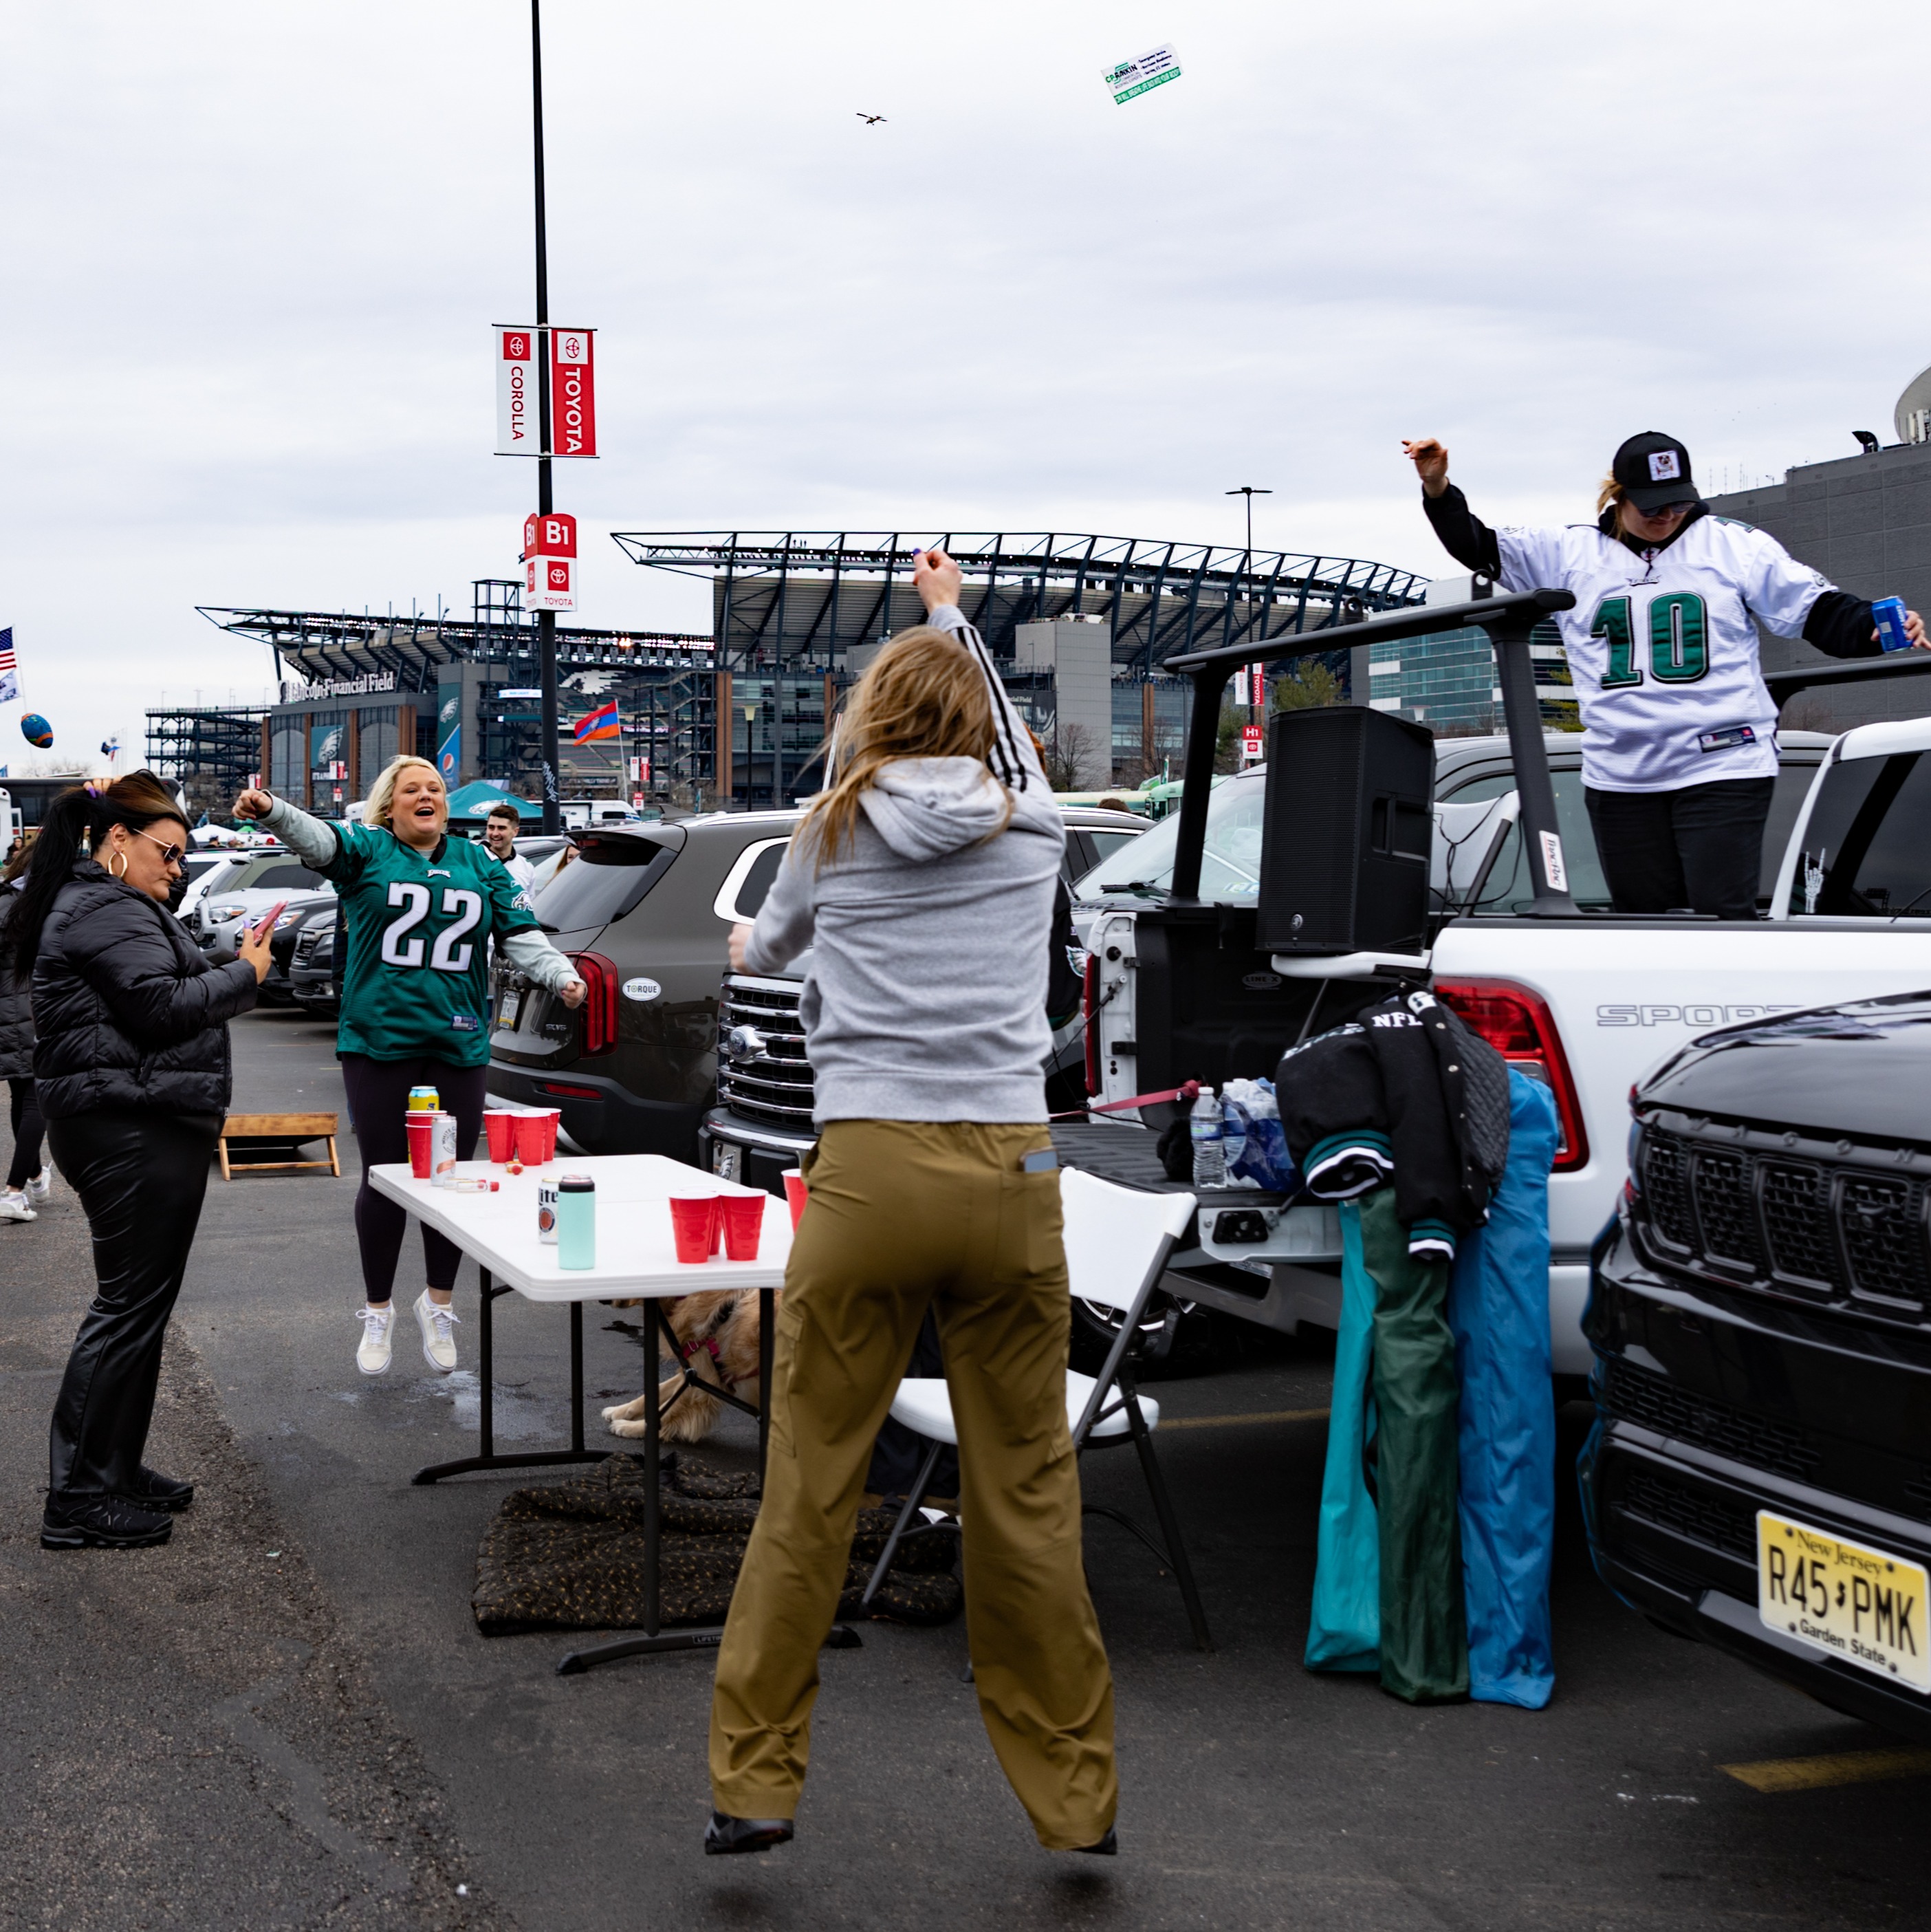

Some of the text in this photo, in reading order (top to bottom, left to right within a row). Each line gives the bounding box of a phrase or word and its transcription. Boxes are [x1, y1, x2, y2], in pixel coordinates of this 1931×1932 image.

[511, 366, 524, 440] COROLLA
[565, 367, 582, 453] TOYOTA
[546, 520, 569, 545] B1
[544, 597, 573, 606] TOYOTA
[1590, 591, 1710, 690] 10
[291, 671, 394, 702] Lincoln Financial Field
[1246, 728, 1258, 737] H1
[381, 881, 483, 972] 22
[626, 985, 657, 994] TORQUE
[1372, 1011, 1423, 1028] NFL
[1597, 1005, 1806, 1027] SPOR
[441, 1128, 452, 1145] WHITE
[1797, 1530, 1883, 1580] New Jersey
[1768, 1543, 1917, 1657] R45 PMK
[1800, 1618, 1886, 1665] Garden State
